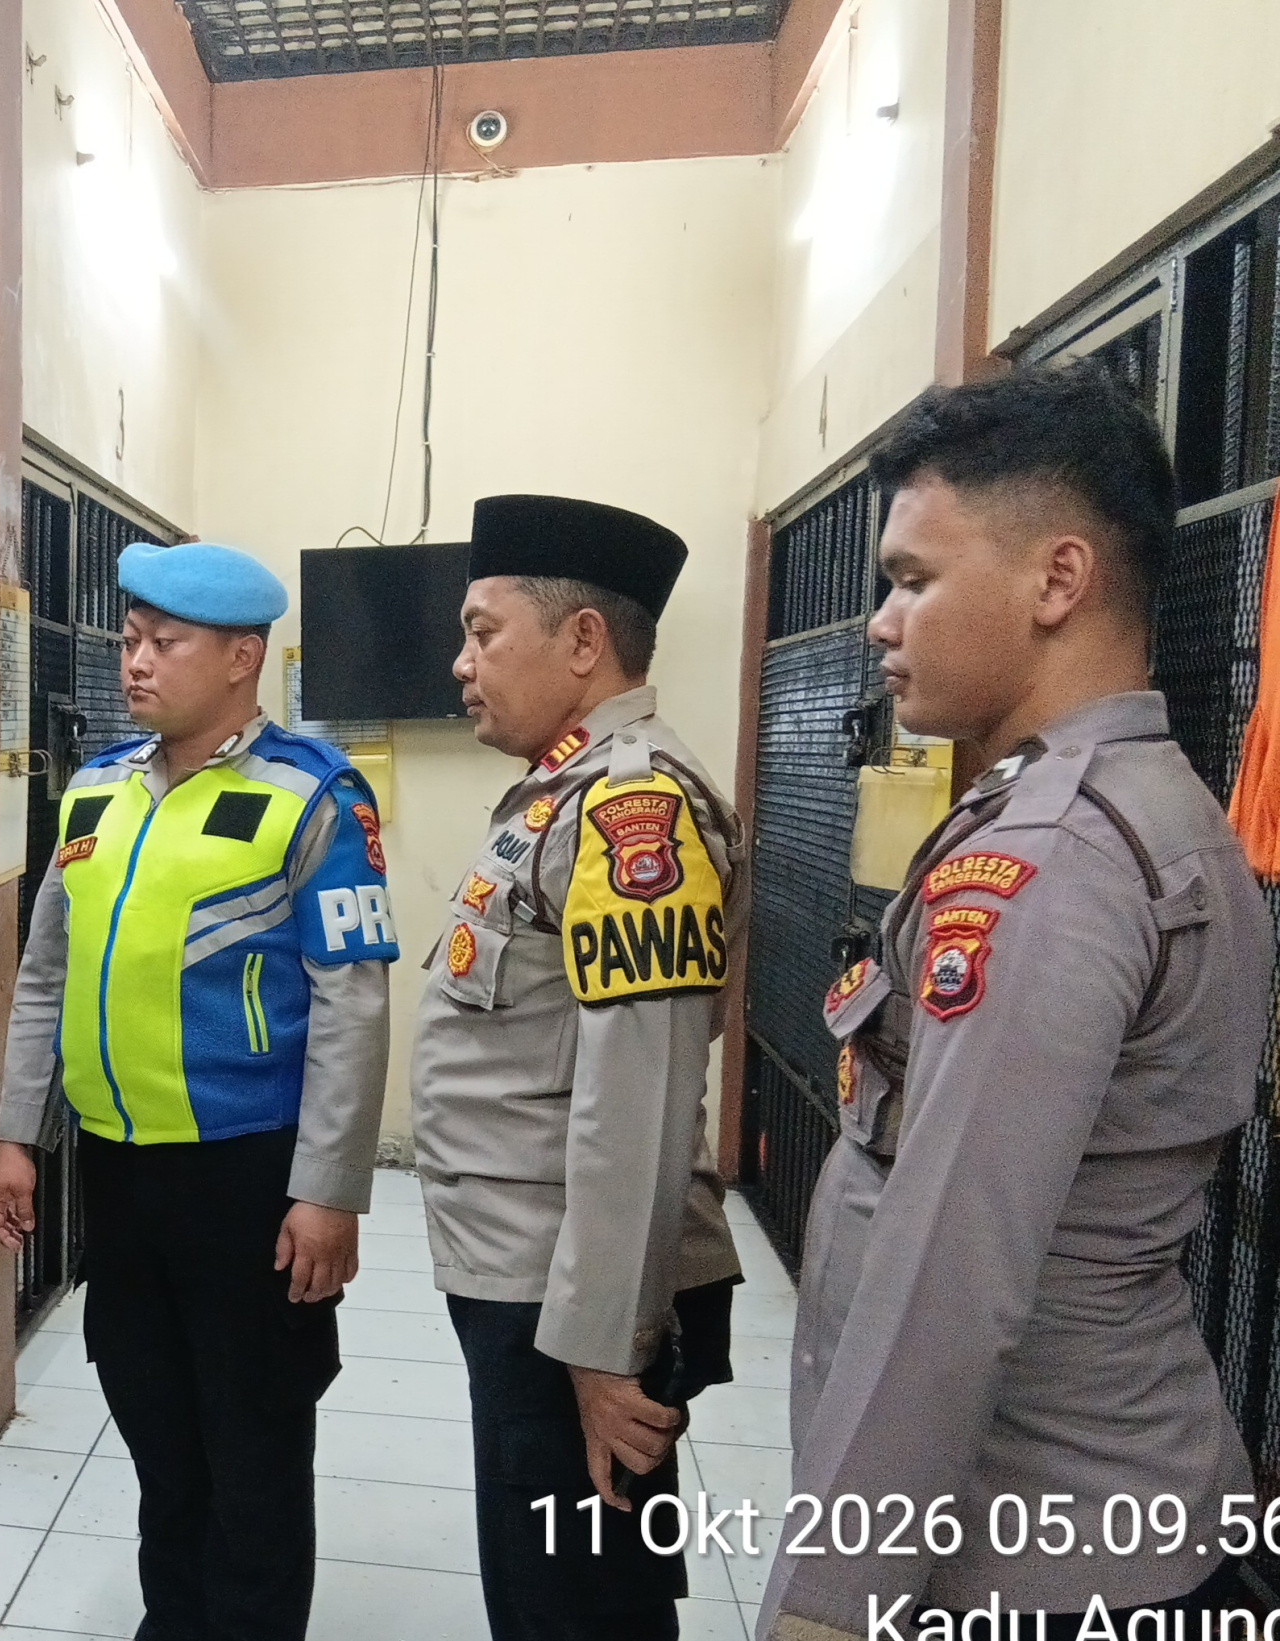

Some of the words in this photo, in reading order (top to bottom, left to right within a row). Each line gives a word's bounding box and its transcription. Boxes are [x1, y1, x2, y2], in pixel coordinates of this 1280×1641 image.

[598, 798, 668, 820] POLRESTA
[604, 806, 666, 824] TANGERANG
[616, 822, 660, 836] BANTEN
[929, 856, 1022, 885] POLRESTA
[929, 870, 1014, 893] TANGERANG
[317, 884, 397, 952] PR
[933, 909, 989, 925] BANTEN
[571, 904, 727, 994] PAWAS
